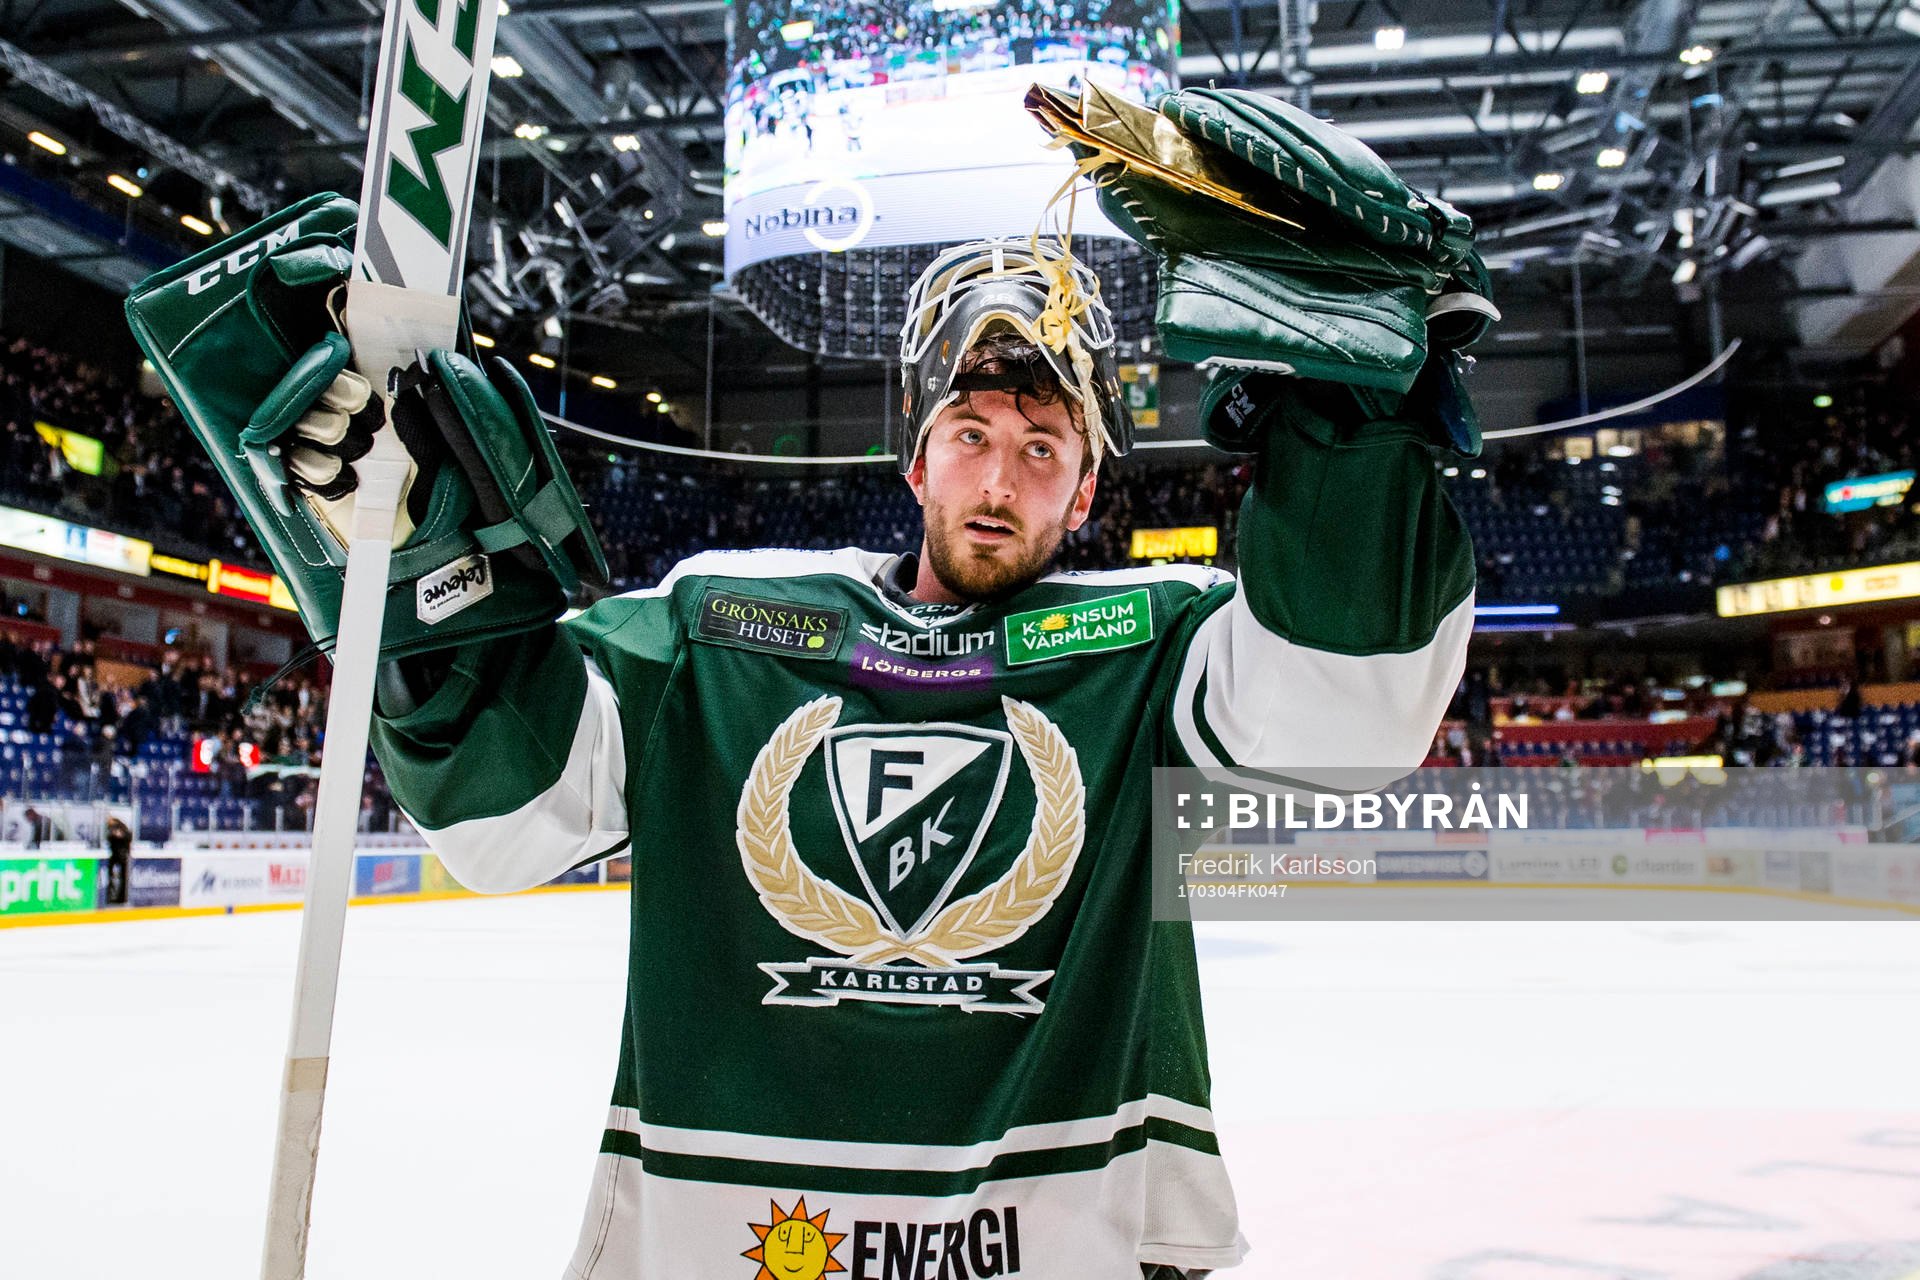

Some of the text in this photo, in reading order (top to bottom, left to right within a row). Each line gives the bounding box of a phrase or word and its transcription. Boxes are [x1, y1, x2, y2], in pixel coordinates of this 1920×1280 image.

[745, 206, 857, 239] Nobina
[183, 220, 299, 295] CCM
[711, 598, 828, 632] GRÖNSAKS
[911, 604, 959, 615] CCM
[737, 621, 809, 647] HUSET
[859, 622, 995, 657] stadium
[1022, 618, 1137, 650] VÄRMLAND
[861, 656, 982, 678] LÖFBERGS
[866, 749, 924, 825] F
[820, 970, 984, 991] KARLSTAD
[851, 1206, 1021, 1280] ENERGI
